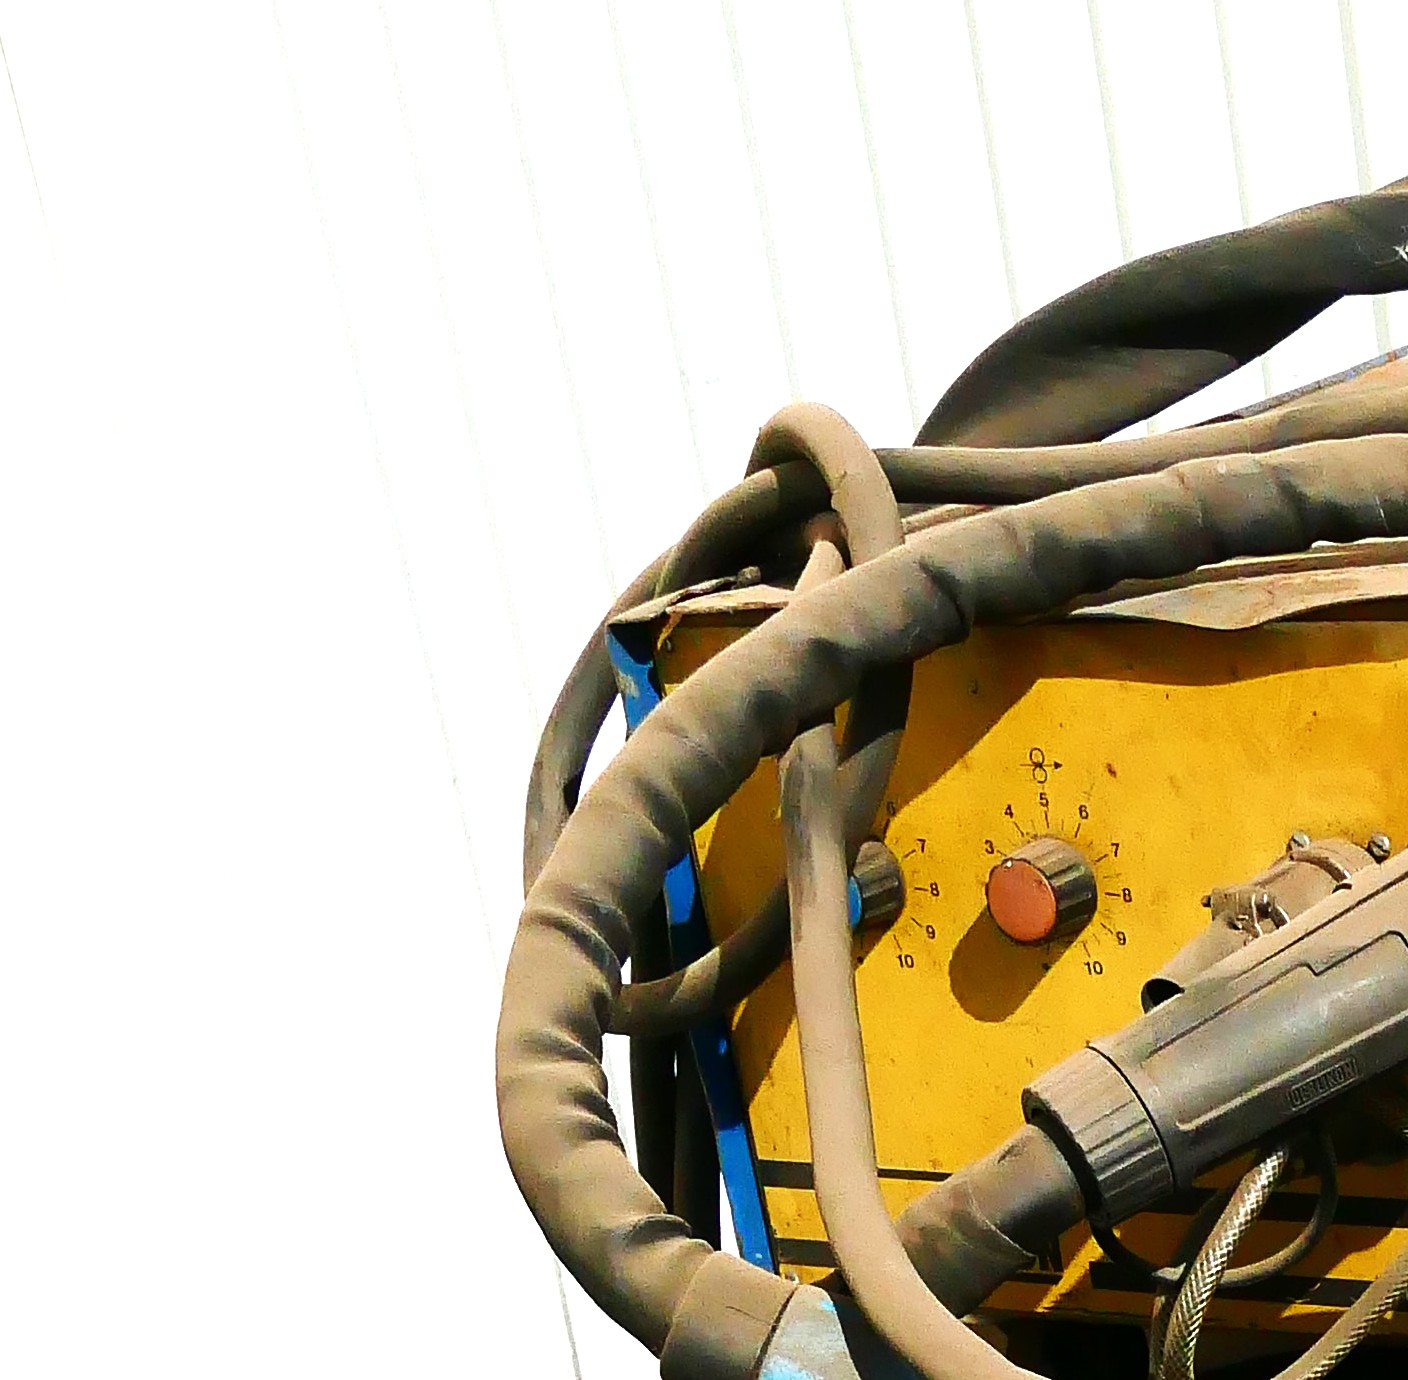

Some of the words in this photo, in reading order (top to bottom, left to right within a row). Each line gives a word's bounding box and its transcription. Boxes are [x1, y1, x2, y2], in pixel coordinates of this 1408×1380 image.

[1039, 793, 1049, 807] 5
[1004, 804, 1014, 818] 4
[1078, 805, 1089, 819] 6
[916, 838, 926, 853] 7
[985, 840, 995, 854] 3
[1110, 843, 1120, 857] 7
[930, 882, 939, 897] 8
[1122, 888, 1132, 902] 8
[925, 925, 935, 939] 9
[1116, 931, 1127, 946] 9
[897, 954, 914, 969] 10
[1084, 961, 1103, 975] 10
